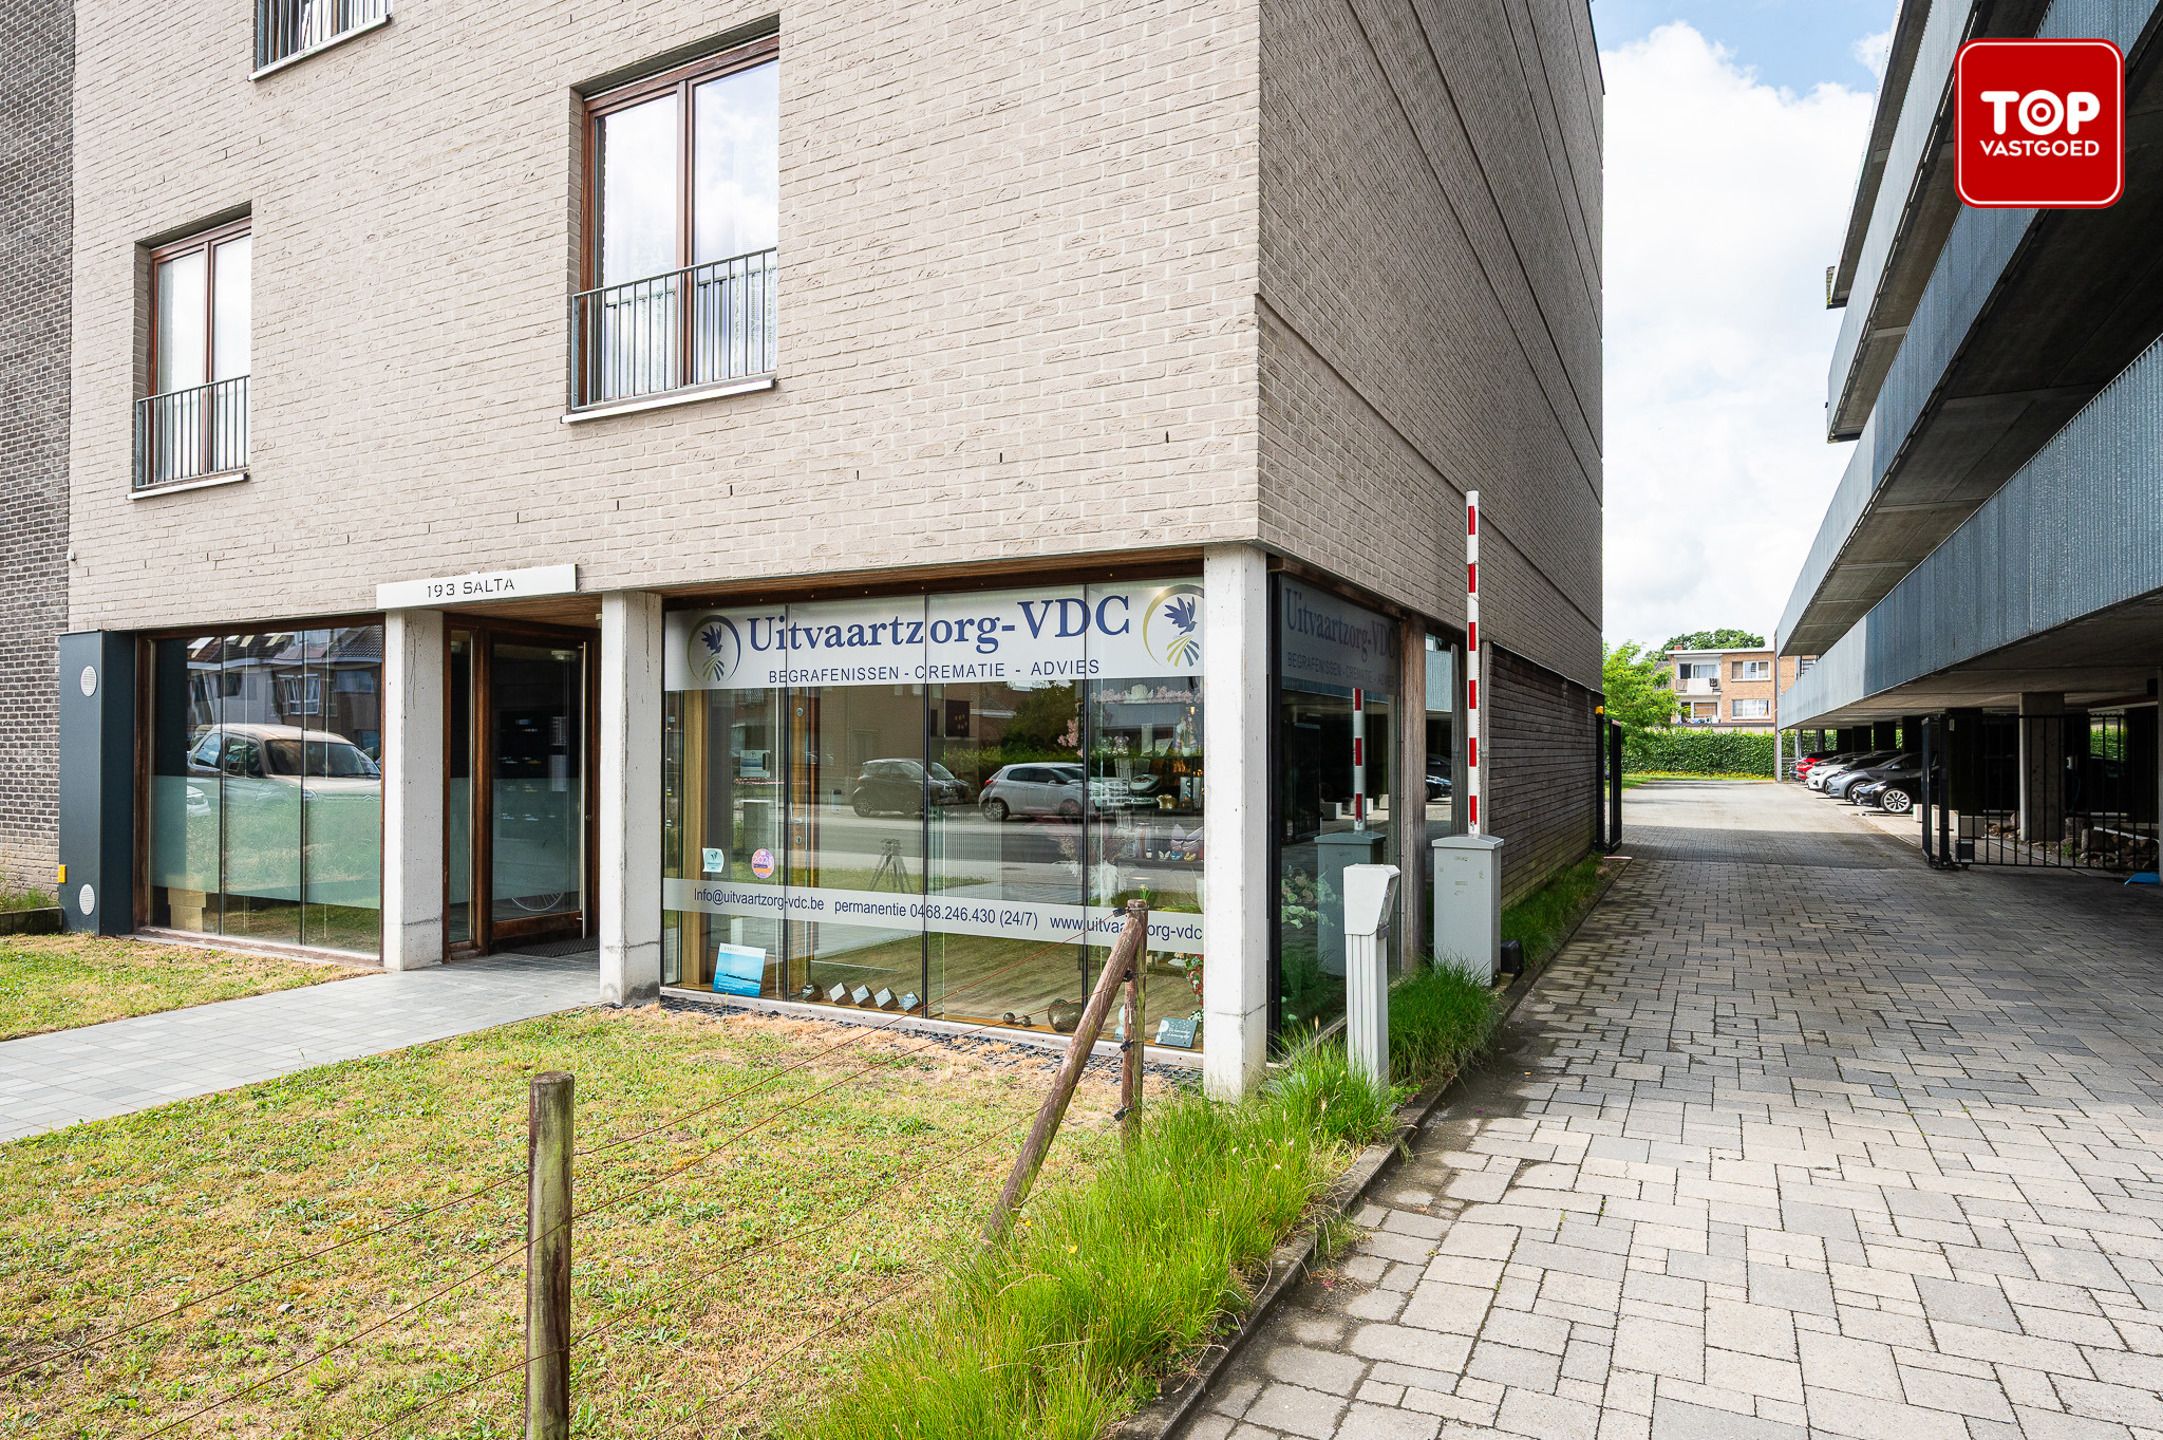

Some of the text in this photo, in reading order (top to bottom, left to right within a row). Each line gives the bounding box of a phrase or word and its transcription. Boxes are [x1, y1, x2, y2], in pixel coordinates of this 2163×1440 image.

[427, 578, 515, 598] 193 SALTA
[747, 595, 1130, 655] Uitvaartzorg-VDC
[769, 666, 899, 684] BEGRAFENISSEN
[915, 662, 1005, 680] CREMATIE
[1030, 659, 1100, 676] ADVIES
[694, 887, 825, 911] Info@uitvaartzorg-vdc.be
[834, 899, 907, 917] permanentie
[910, 903, 996, 925] 0468.246.430
[999, 912, 1039, 930] (24/7)
